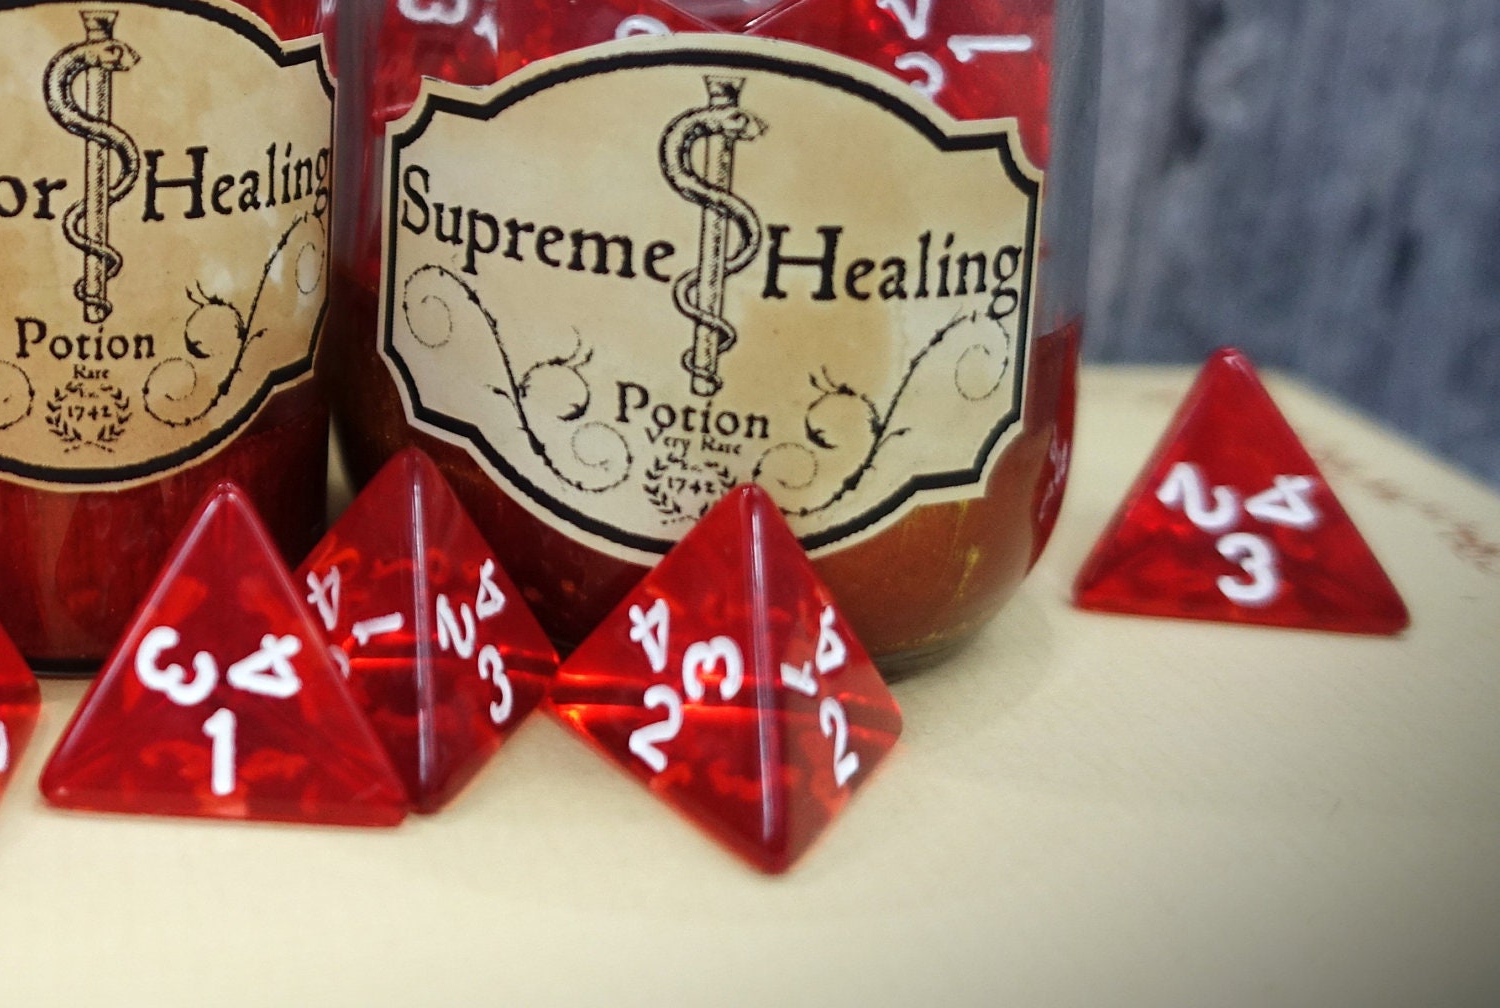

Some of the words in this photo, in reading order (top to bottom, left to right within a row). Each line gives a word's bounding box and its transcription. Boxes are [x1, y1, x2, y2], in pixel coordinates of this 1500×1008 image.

[947, 34, 1034, 63] 1
[141, 141, 330, 222] Healing
[401, 165, 677, 283] Supreme
[761, 224, 1022, 320] Healing
[14, 316, 156, 360] Potion
[73, 363, 110, 380] Rare
[67, 405, 113, 422] 1742
[615, 381, 770, 439] Potion
[667, 477, 716, 494] 1742
[1156, 462, 1239, 531] 2
[1244, 475, 1317, 527] 4
[306, 566, 341, 631] 4
[1217, 532, 1278, 604] 3
[351, 612, 404, 646] 1
[436, 594, 476, 659] 2
[628, 598, 669, 673] 4
[135, 626, 218, 706] 3
[227, 634, 301, 698] 4
[477, 644, 513, 724] 3
[682, 636, 743, 702] 3
[203, 708, 235, 796] 1
[628, 684, 684, 772] 2
[819, 697, 859, 787] 2
